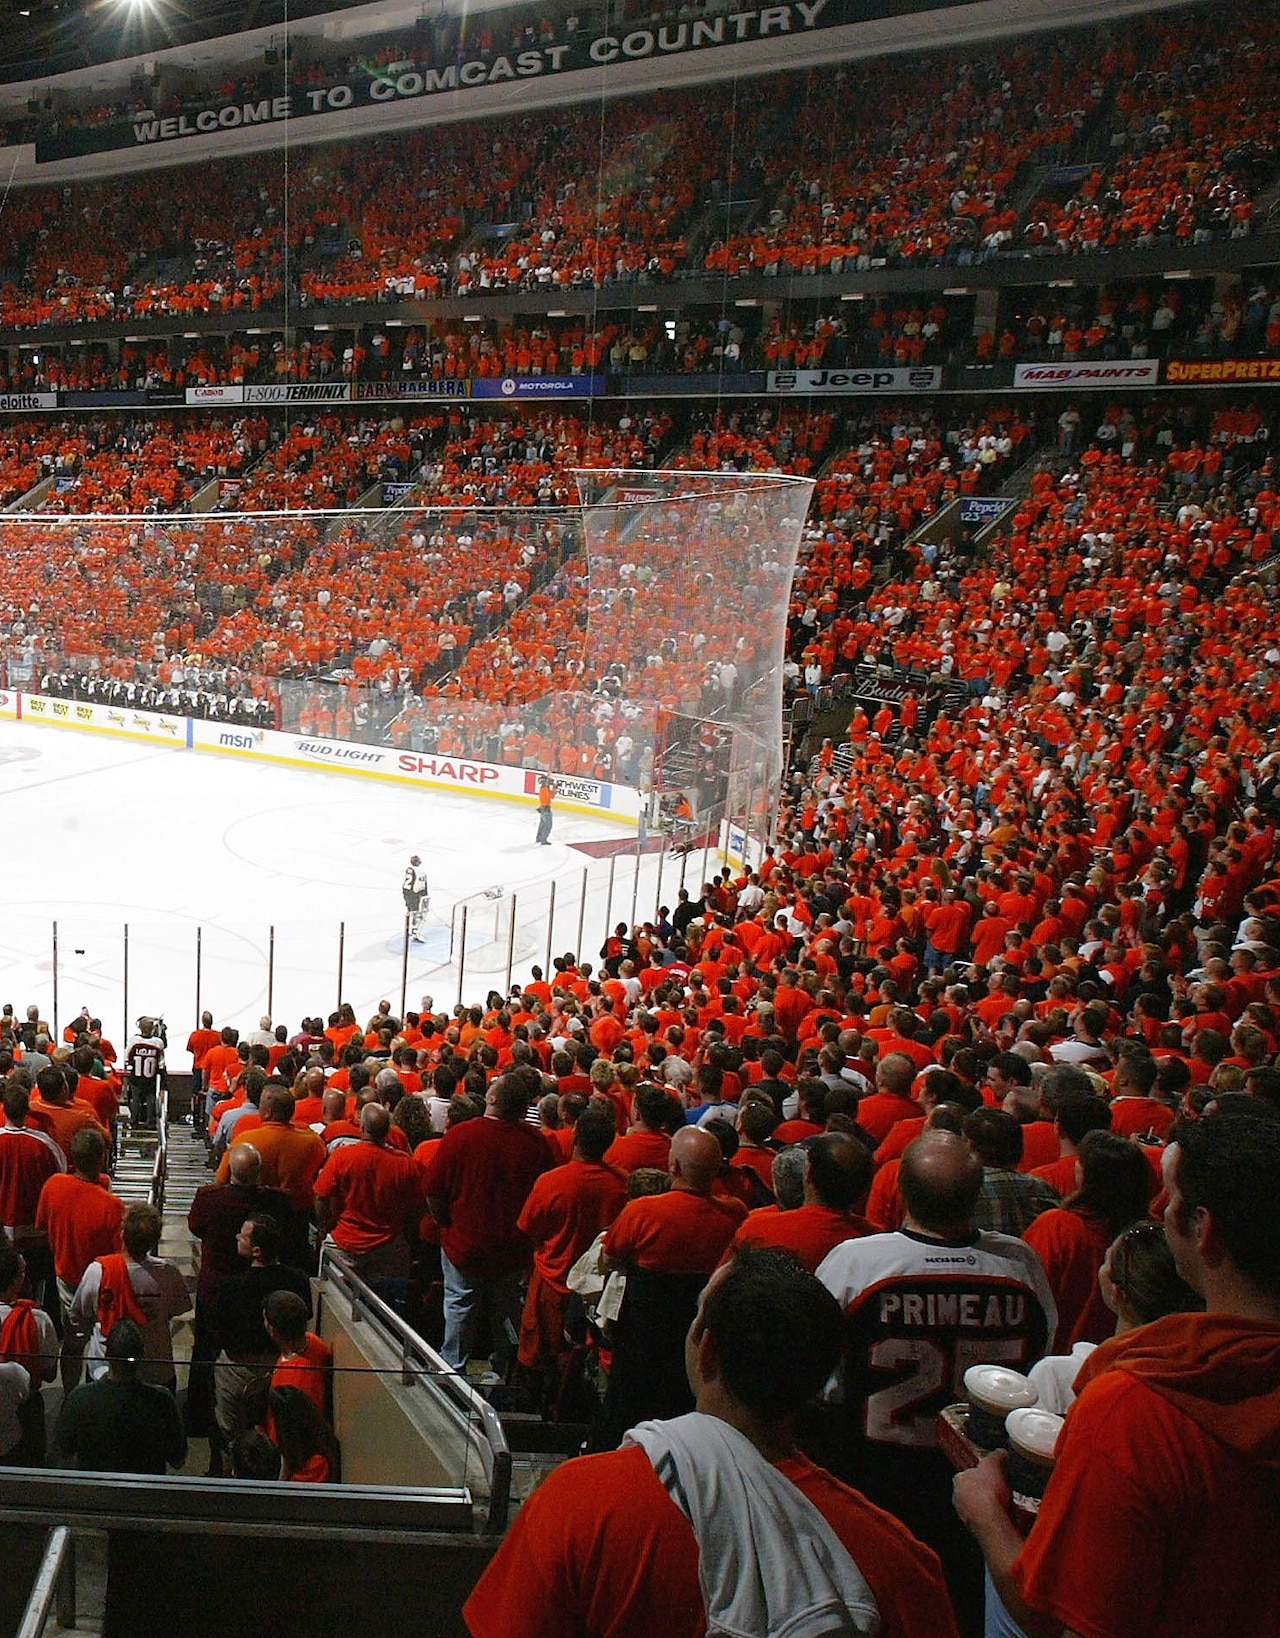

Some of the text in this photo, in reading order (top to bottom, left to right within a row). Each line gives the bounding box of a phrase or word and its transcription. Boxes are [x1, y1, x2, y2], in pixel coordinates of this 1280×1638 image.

[133, 1, 824, 142] WELCOME TO COMCAST COUNTRY
[810, 371, 895, 388] Jeep
[1024, 367, 1152, 380] MAB PAINTS
[194, 387, 223, 396] Canon
[246, 383, 347, 400] 1-800-TERMINIX
[356, 379, 466, 398] GARY BARBERA
[518, 381, 575, 391] MOTOROLA
[969, 501, 1007, 514] Pepcid
[961, 512, 980, 521] 123
[30, 698, 46, 706] BEST
[31, 704, 45, 713] BUY
[220, 731, 252, 749] msn
[299, 742, 385, 763] BUD LIGHT
[398, 754, 499, 784] SHARP
[133, 1055, 157, 1078] 10
[925, 1255, 965, 1264] KOHO
[880, 1293, 1027, 1328] PRIMEAU
